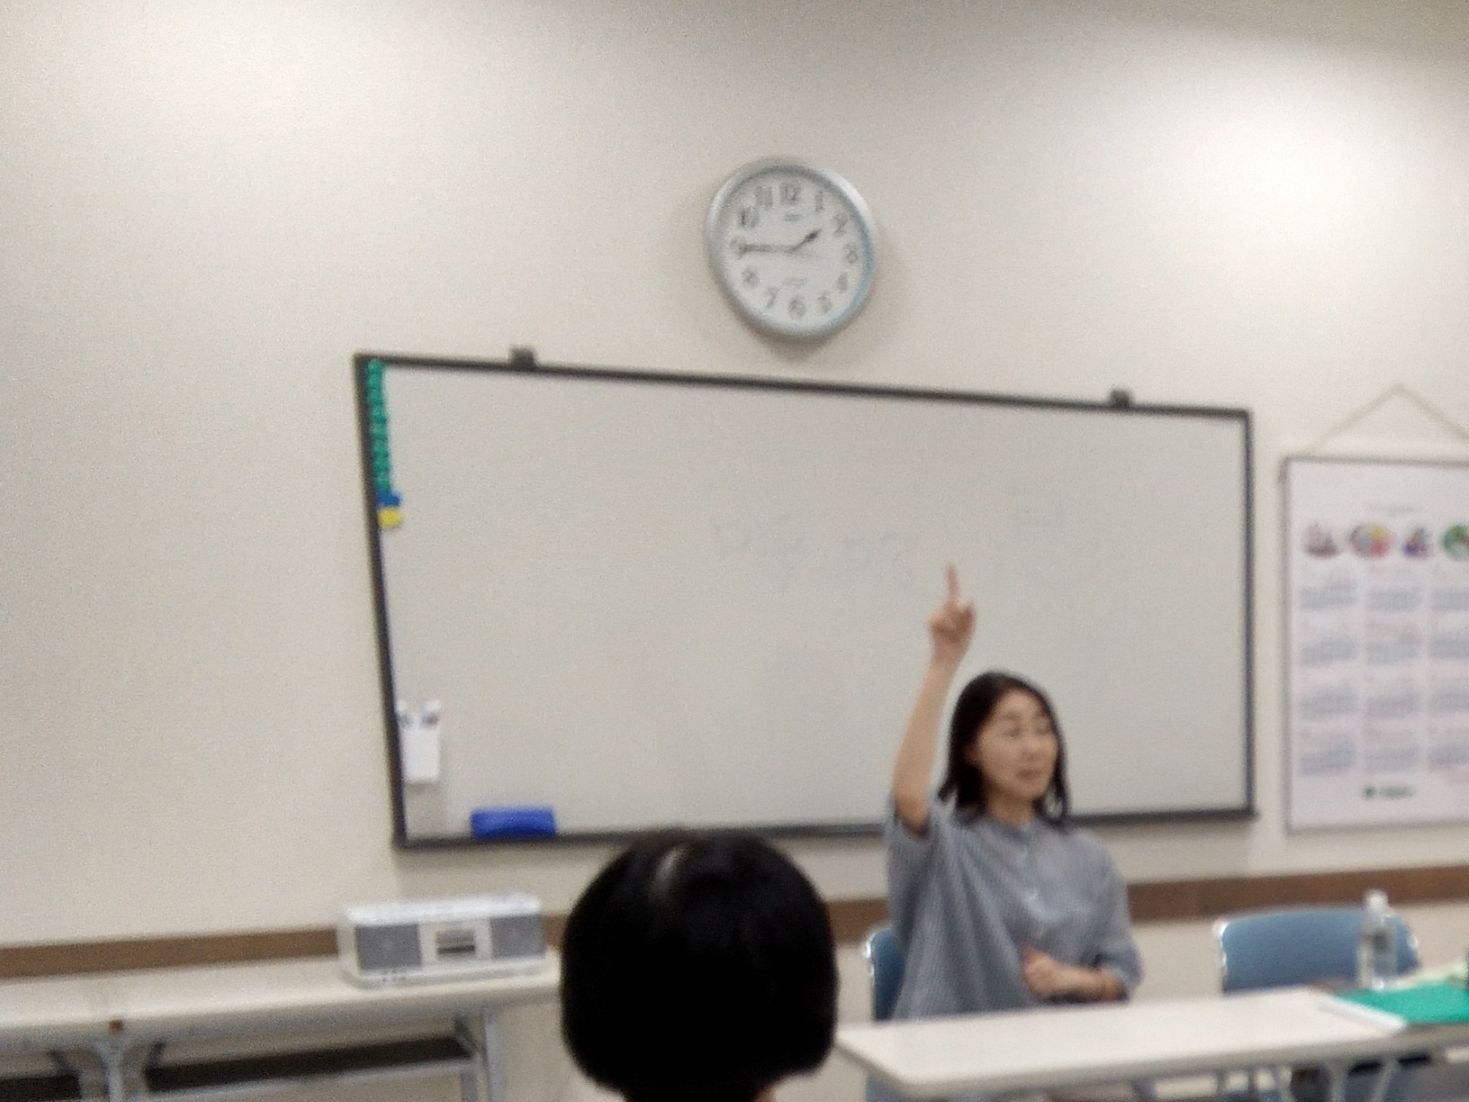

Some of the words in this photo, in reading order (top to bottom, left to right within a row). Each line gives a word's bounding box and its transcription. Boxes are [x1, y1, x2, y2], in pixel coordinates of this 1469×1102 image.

[779, 182, 802, 203] 12
[738, 208, 759, 229] 10
[832, 212, 849, 235] 2
[765, 287, 780, 308] 7
